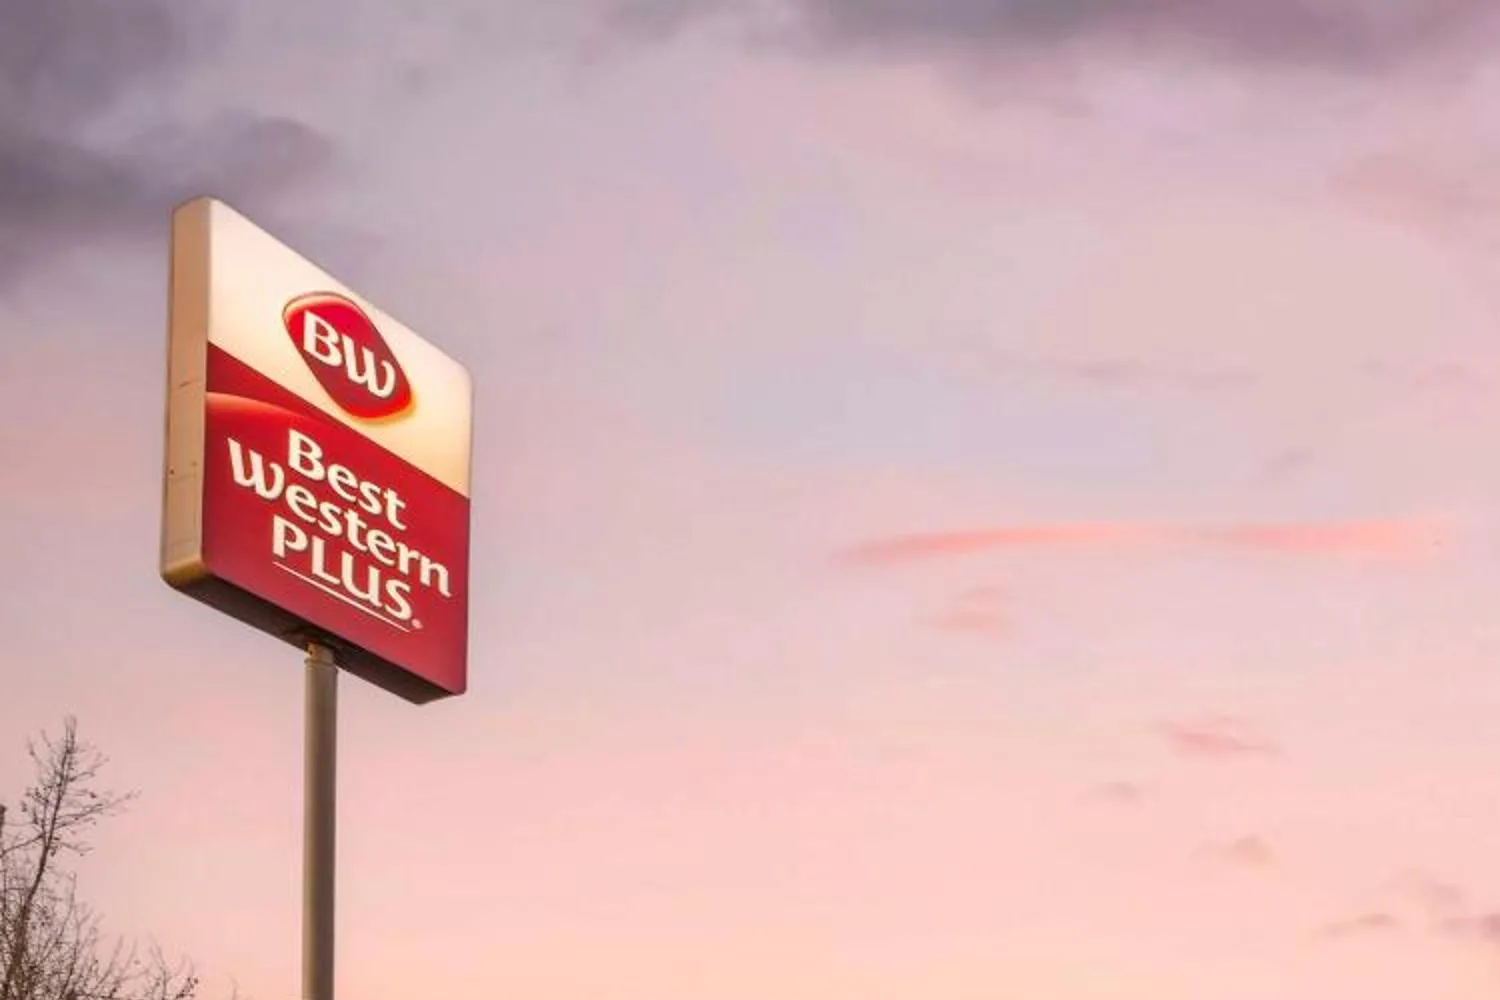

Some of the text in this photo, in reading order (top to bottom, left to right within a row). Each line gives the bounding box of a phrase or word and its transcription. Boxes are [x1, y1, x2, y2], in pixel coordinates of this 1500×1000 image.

[304, 312, 396, 398] BW
[228, 438, 452, 597] Western
[289, 430, 406, 530] Best
[273, 516, 413, 621] PLUS
